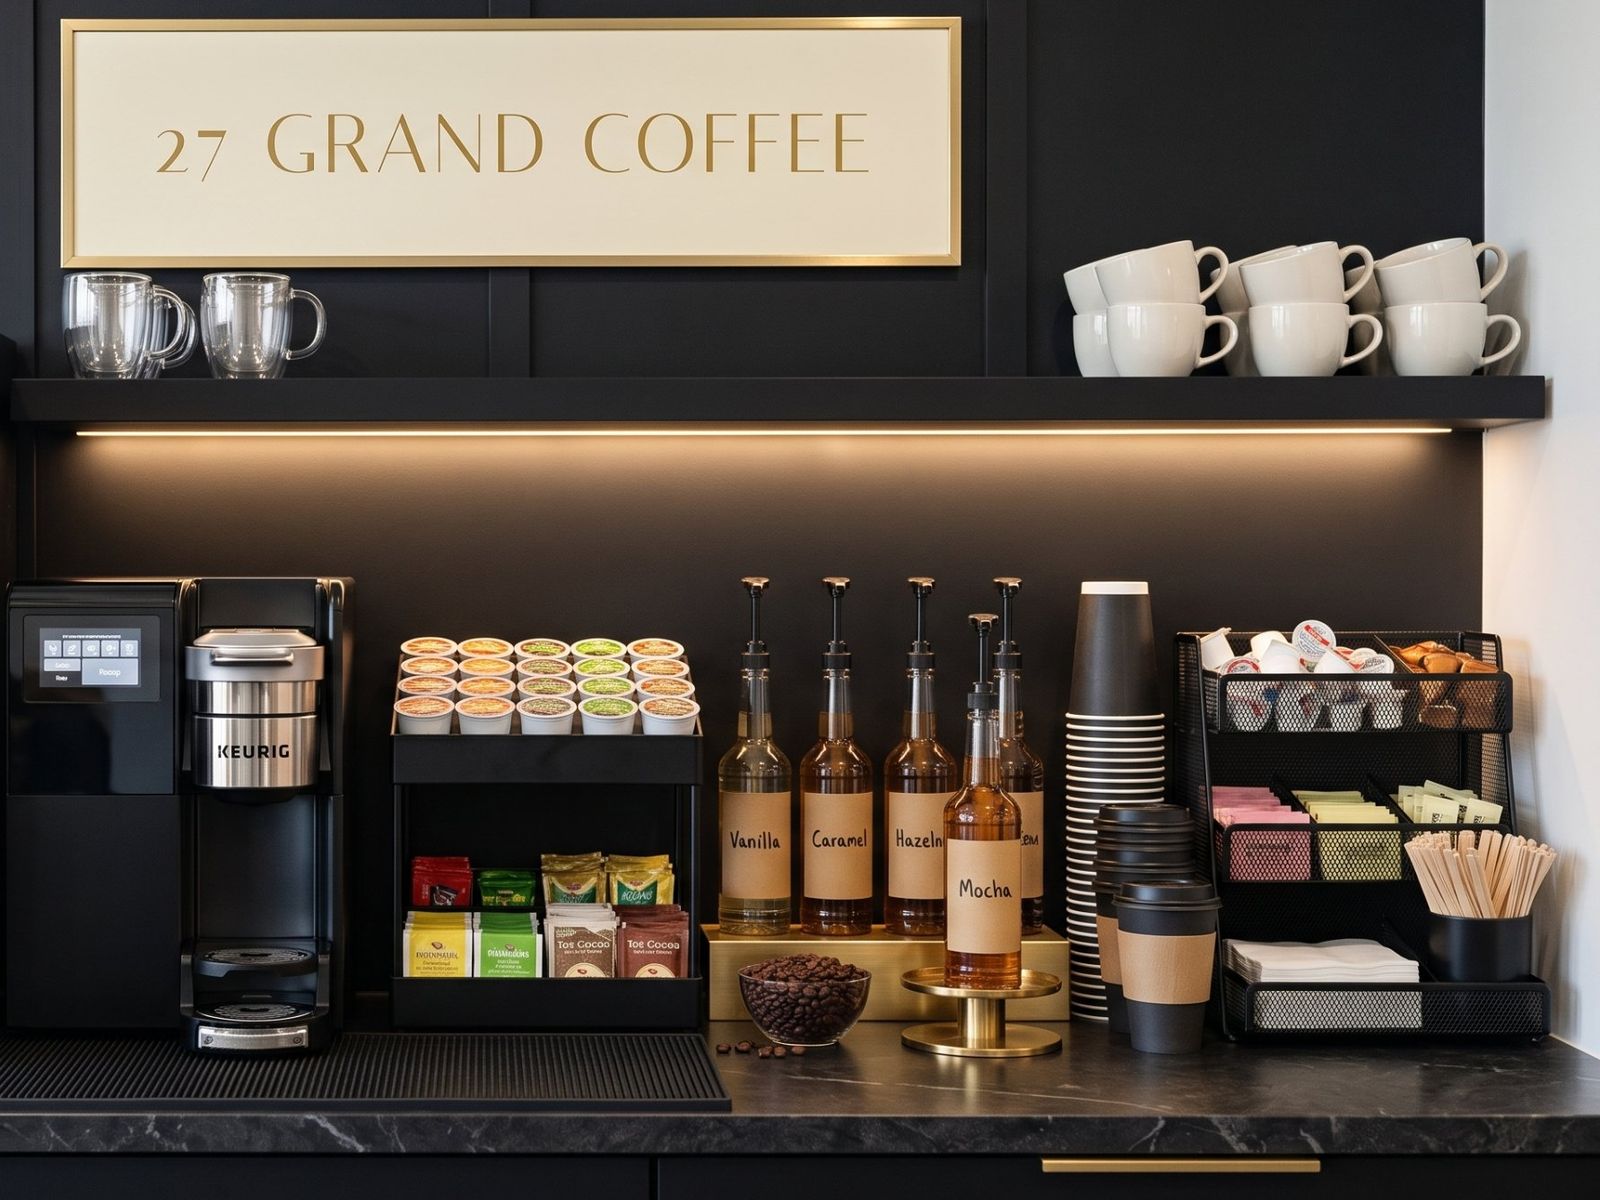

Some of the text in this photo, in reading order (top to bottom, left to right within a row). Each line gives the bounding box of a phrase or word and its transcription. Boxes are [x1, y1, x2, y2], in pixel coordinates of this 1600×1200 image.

[155, 112, 870, 183] 27 GRAND COFFEE
[217, 744, 290, 759] KEURIG
[729, 831, 781, 850] Vanilla
[812, 829, 868, 848] Caramel
[896, 828, 943, 848] Hazeln
[959, 878, 1012, 899] Mocha
